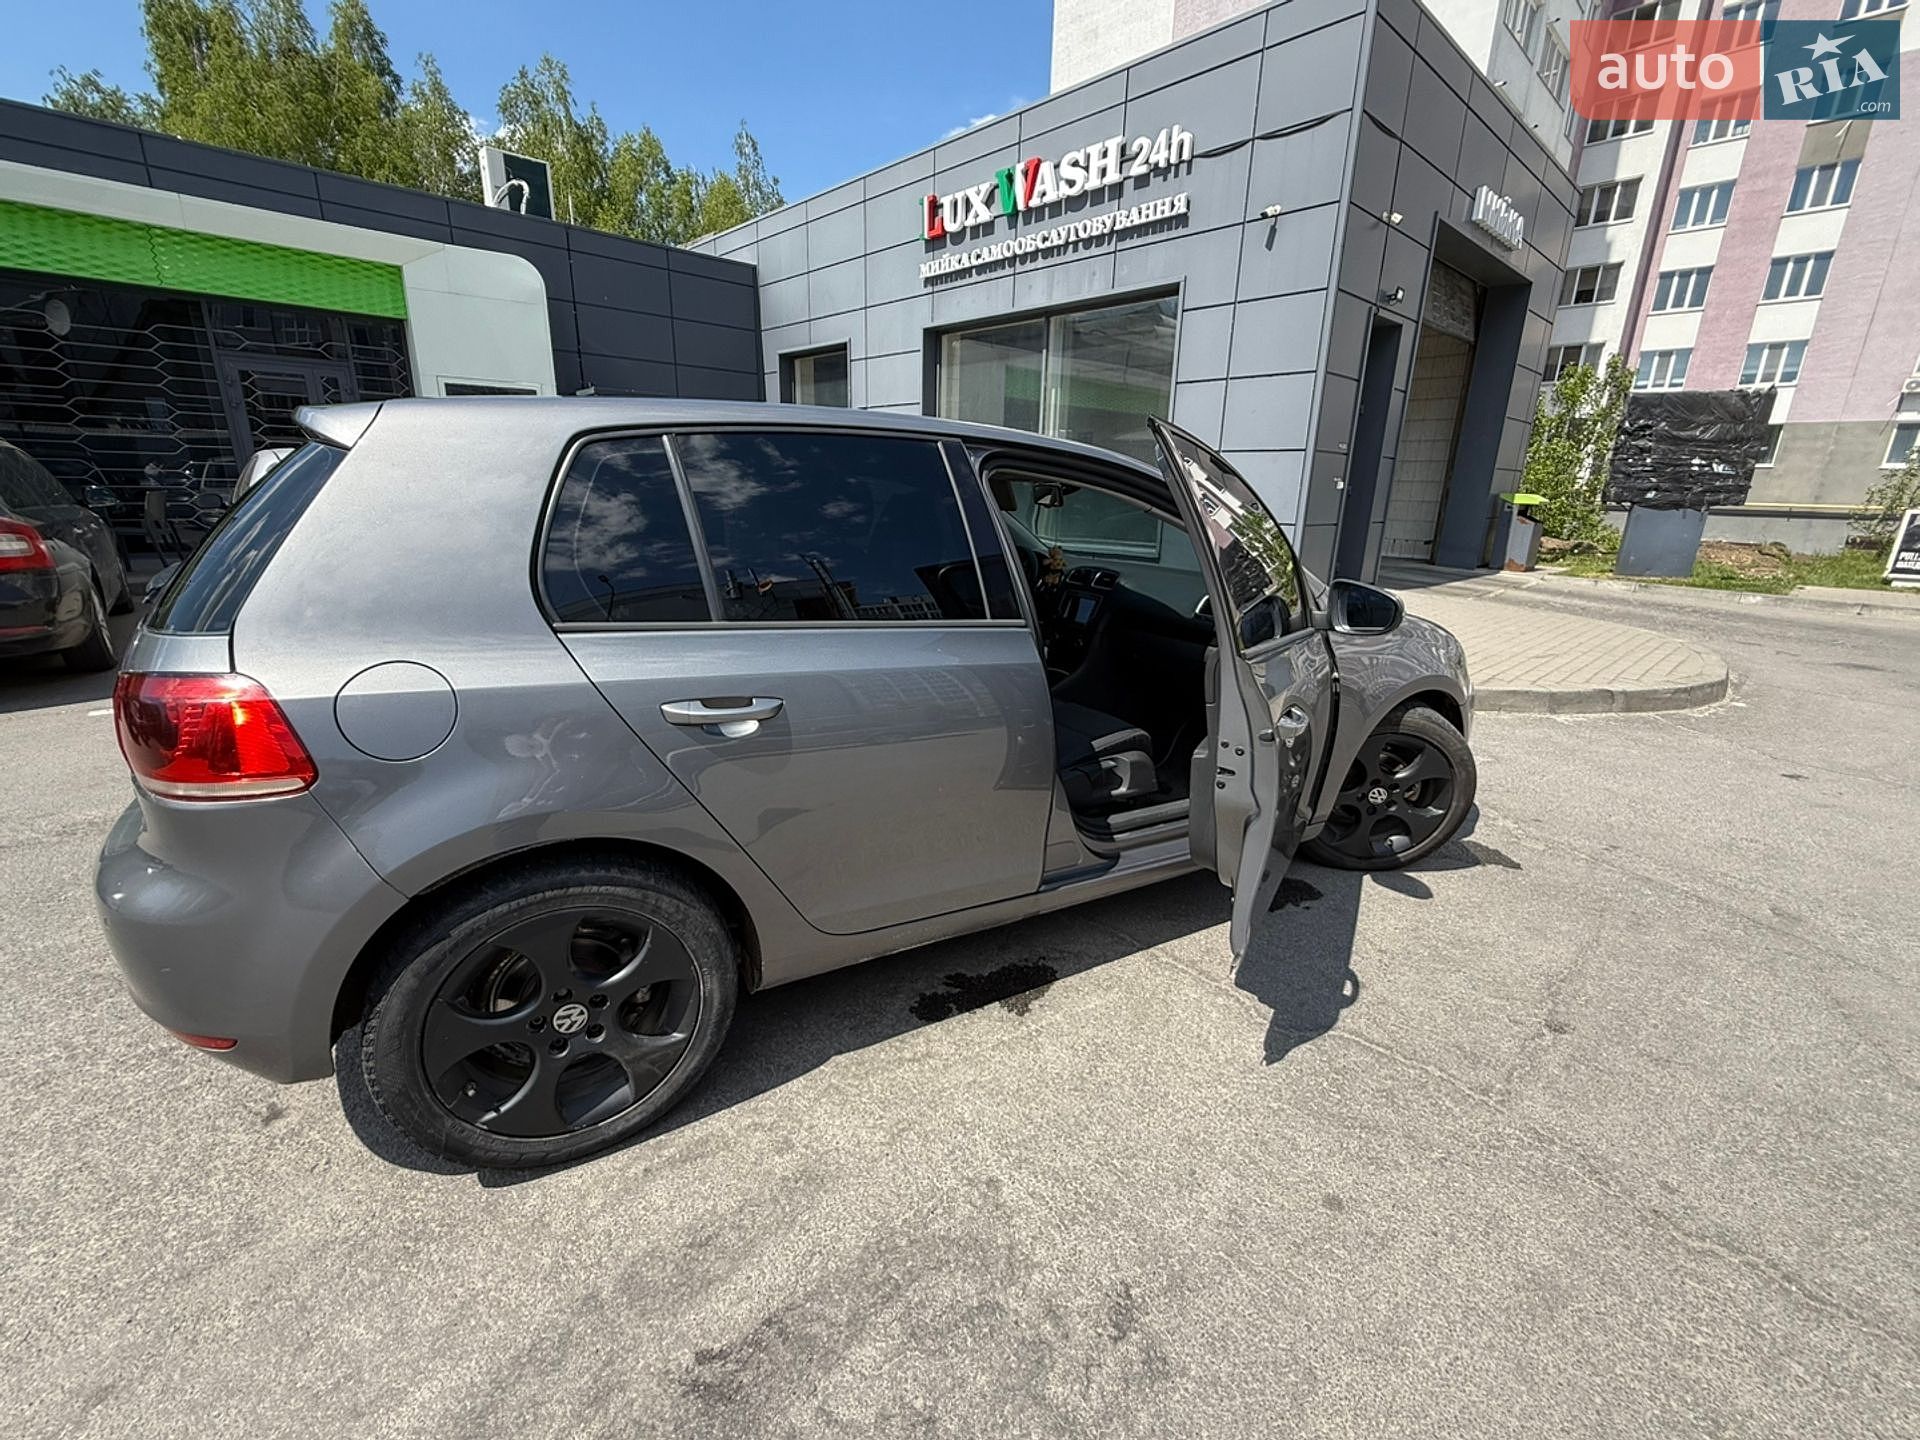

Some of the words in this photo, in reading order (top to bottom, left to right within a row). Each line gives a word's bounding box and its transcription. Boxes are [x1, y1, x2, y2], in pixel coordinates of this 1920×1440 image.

[919, 182, 999, 240] LUX
[995, 135, 1127, 216] WASH
[1129, 124, 1194, 177] 24h
